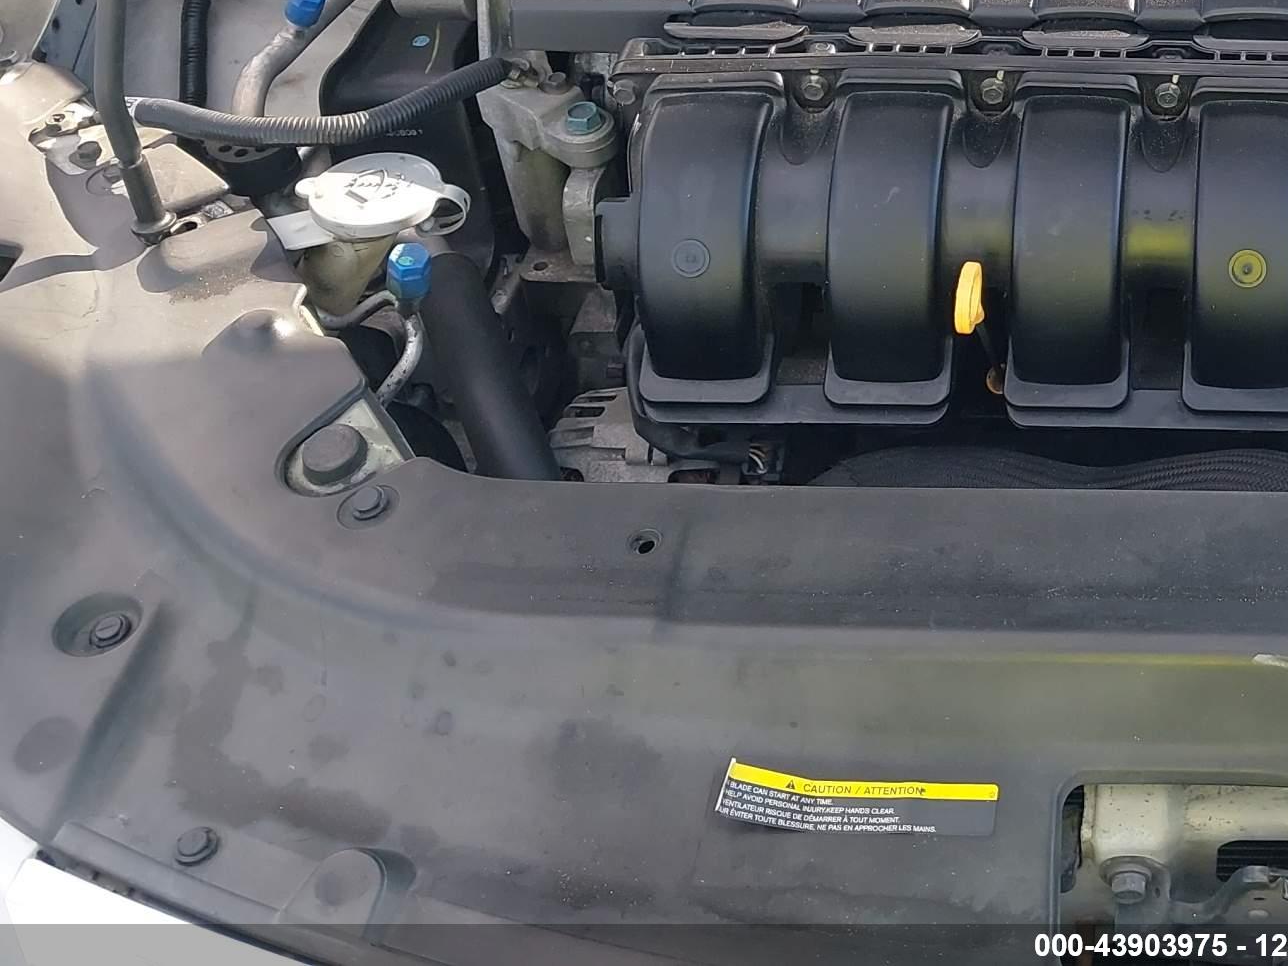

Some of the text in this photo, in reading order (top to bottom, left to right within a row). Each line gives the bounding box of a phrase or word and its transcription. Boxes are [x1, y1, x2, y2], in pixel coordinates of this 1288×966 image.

[729, 781, 753, 794] BLADE
[752, 785, 769, 796] CAN
[769, 789, 791, 802] START
[790, 793, 801, 802] AT
[800, 796, 816, 805] ANY
[803, 783, 852, 795] CAUTION
[863, 786, 922, 796] ATTENTION
[724, 789, 742, 800] HELP
[742, 793, 764, 805] AVOID
[764, 796, 801, 812] PERSONAL
[845, 806, 870, 815] HANDS
[871, 807, 895, 815] CLEAR.
[729, 806, 755, 820] ÉVITER
[754, 814, 777, 825] TOUTE
[817, 822, 827, 831] NE
[827, 823, 842, 832] PAS
[843, 824, 854, 832] EN
[854, 824, 898, 833] APPROCHER
[898, 824, 912, 832] LES
[912, 825, 937, 833] MAINS.
[765, 806, 792, 820] RISQUE
[792, 812, 803, 821] DE
[803, 813, 842, 824] DÉMARRER
[849, 815, 868, 824] TOUT
[868, 815, 901, 825] MOMENT.
